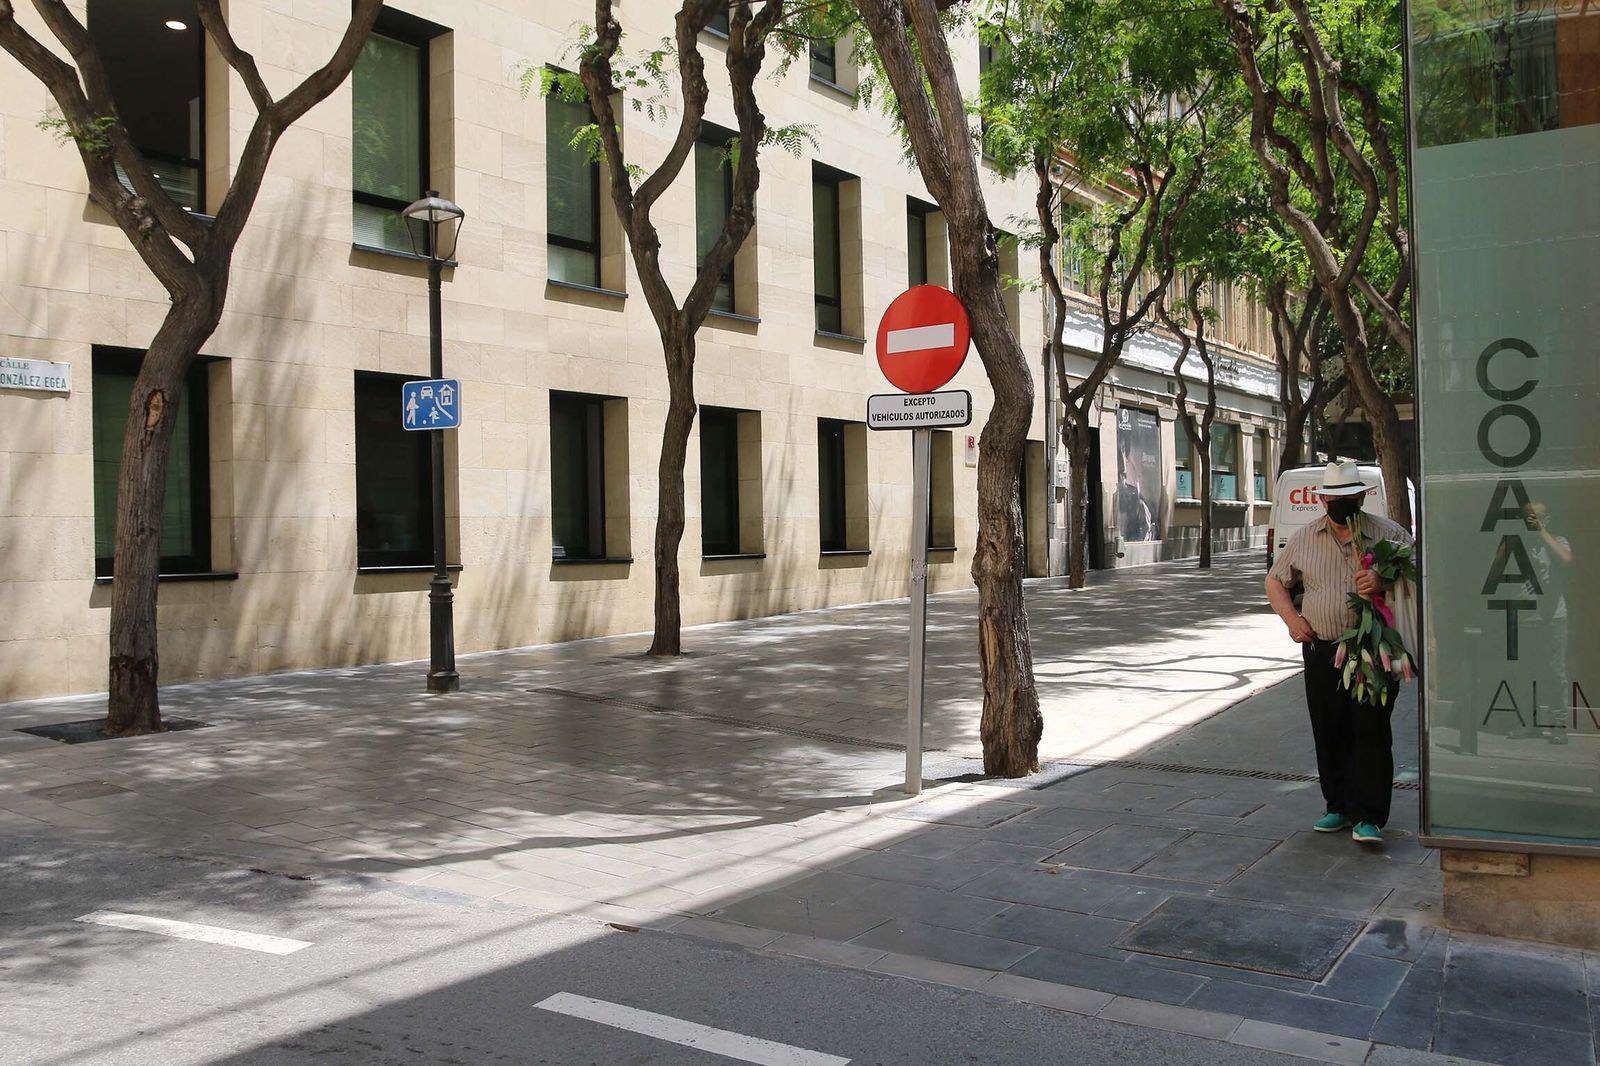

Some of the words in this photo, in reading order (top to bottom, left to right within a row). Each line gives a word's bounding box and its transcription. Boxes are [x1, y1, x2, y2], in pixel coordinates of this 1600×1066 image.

[0, 360, 30, 369] CALLE
[0, 373, 41, 387] ONZÁLEZ
[904, 397, 936, 407] EXCEPTO
[872, 411, 914, 421] VEHÍCULOS
[915, 409, 965, 420] AUTORIZADOS
[1476, 337, 1543, 660] COAAT
